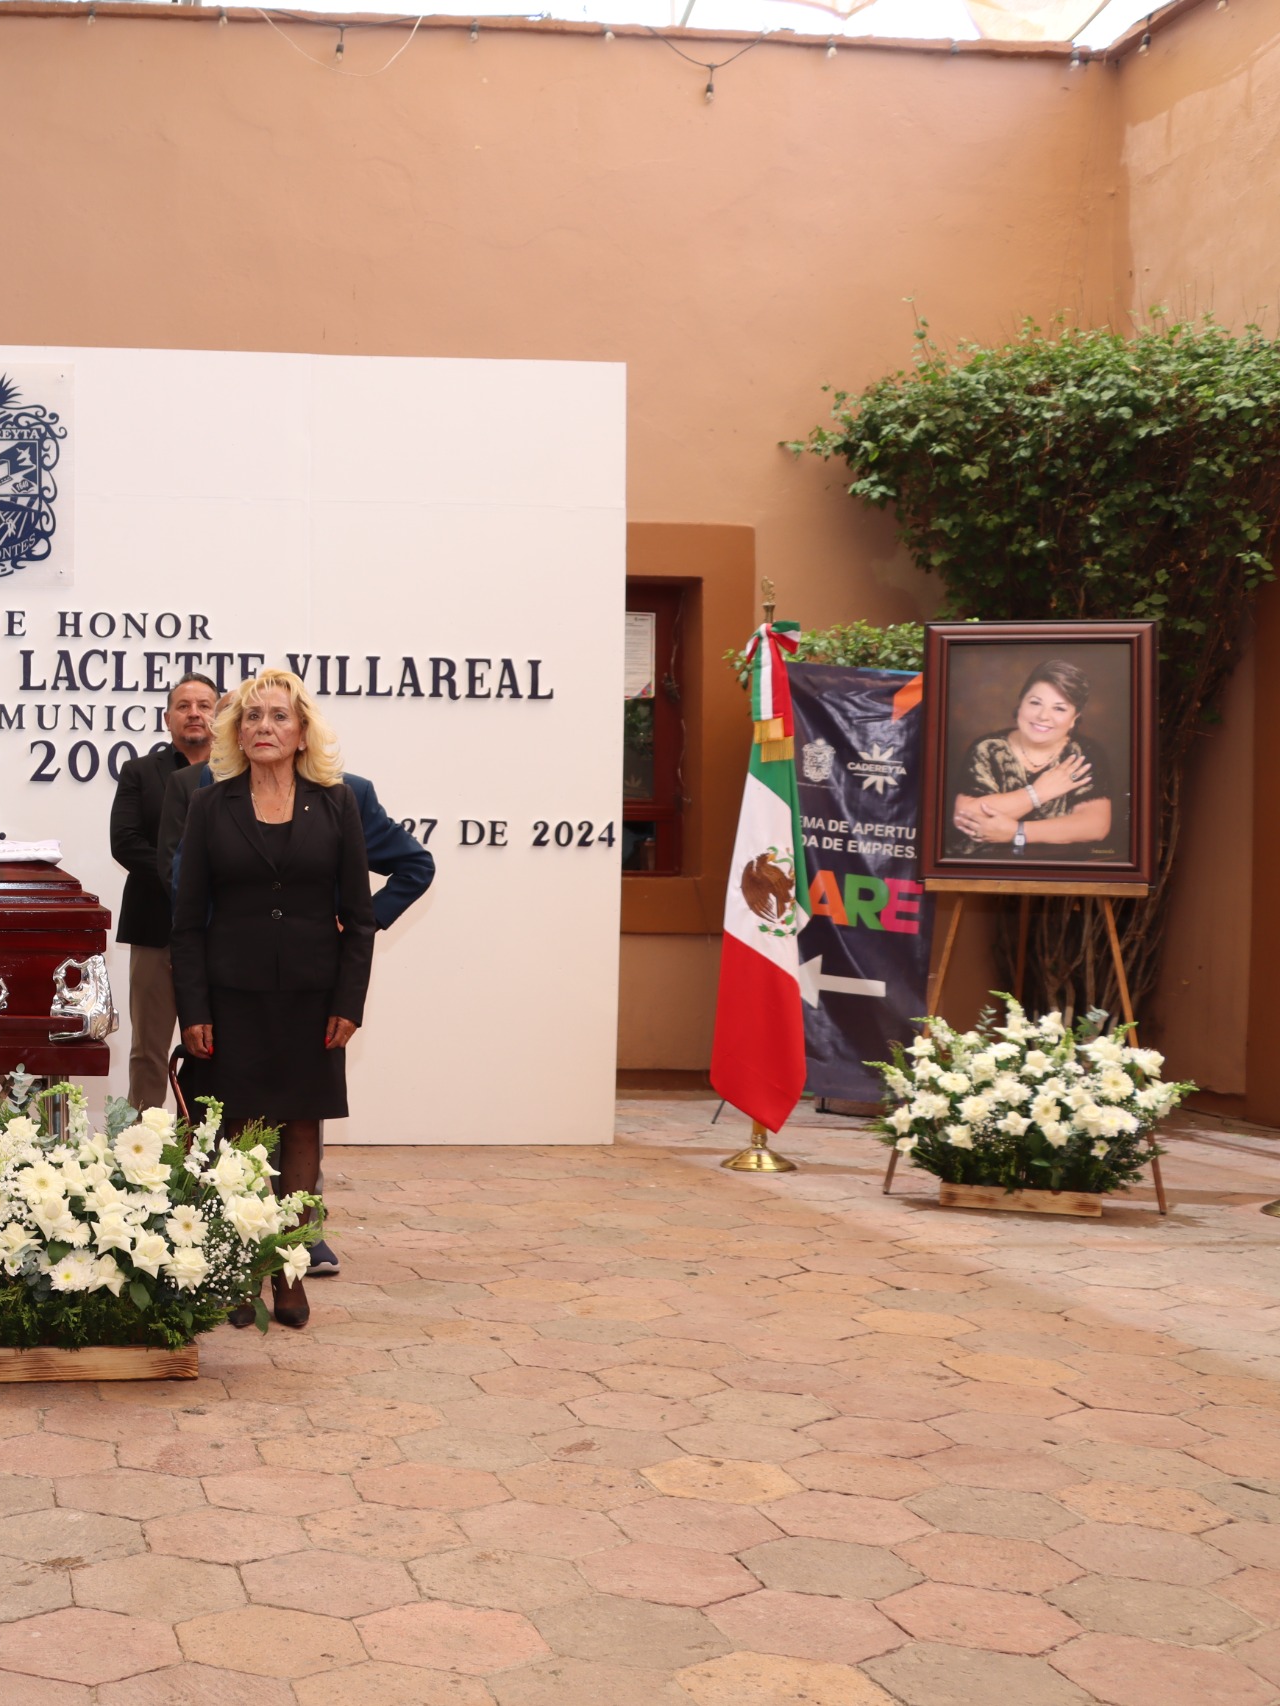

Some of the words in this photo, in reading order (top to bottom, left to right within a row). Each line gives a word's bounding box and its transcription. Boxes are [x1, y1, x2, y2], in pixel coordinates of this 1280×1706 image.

[57, 609, 213, 641] HONOR
[20, 649, 265, 692] LACLETTE
[286, 653, 555, 701] VILLAREAL
[30, 740, 171, 783] 200
[847, 762, 907, 776] CADEREYTA
[459, 819, 509, 848] DE
[532, 820, 616, 848] 2024
[799, 815, 826, 830] MA
[828, 819, 849, 834] DE
[851, 822, 917, 840] APERTU
[822, 836, 844, 851] DE
[847, 839, 917, 859] EMPRES
[809, 869, 923, 935] ARE
